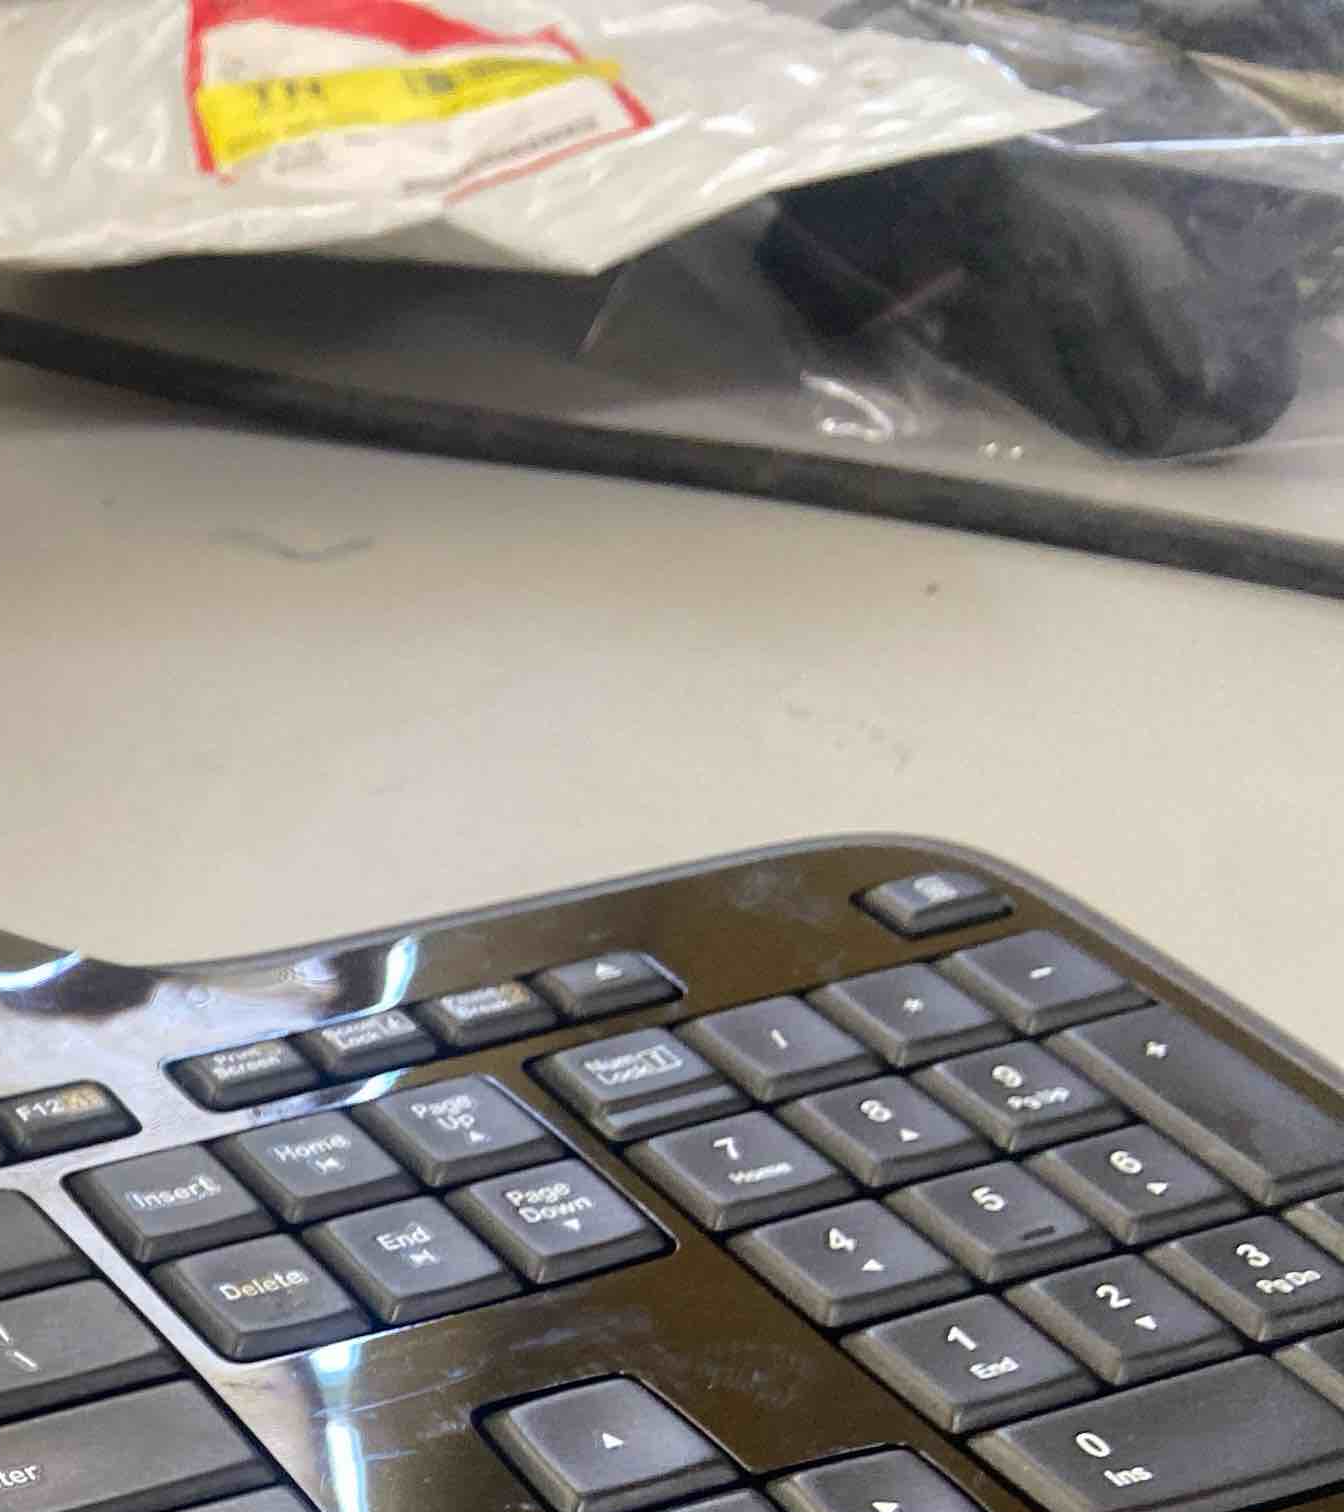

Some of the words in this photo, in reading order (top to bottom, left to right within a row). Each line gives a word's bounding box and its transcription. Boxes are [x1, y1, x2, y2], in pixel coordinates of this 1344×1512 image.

[992, 1065, 1023, 1088] 9
[16, 1098, 62, 1123] F12
[411, 1092, 473, 1122] Page
[860, 1100, 893, 1122] 8
[273, 1133, 352, 1162] Home
[713, 1136, 740, 1161] 7
[1110, 1150, 1143, 1174] 6
[132, 1176, 221, 1211] Insert
[506, 1180, 571, 1208] Page
[972, 1187, 1006, 1211] 5
[518, 1195, 593, 1226] Down
[376, 1225, 432, 1251] End
[829, 1228, 855, 1251] 4
[1236, 1243, 1271, 1267] 3
[218, 1270, 305, 1302] Delete
[1095, 1284, 1132, 1309] 2
[947, 1326, 977, 1351] 1
[1075, 1432, 1112, 1458] 0
[1103, 1466, 1153, 1487] Ins
